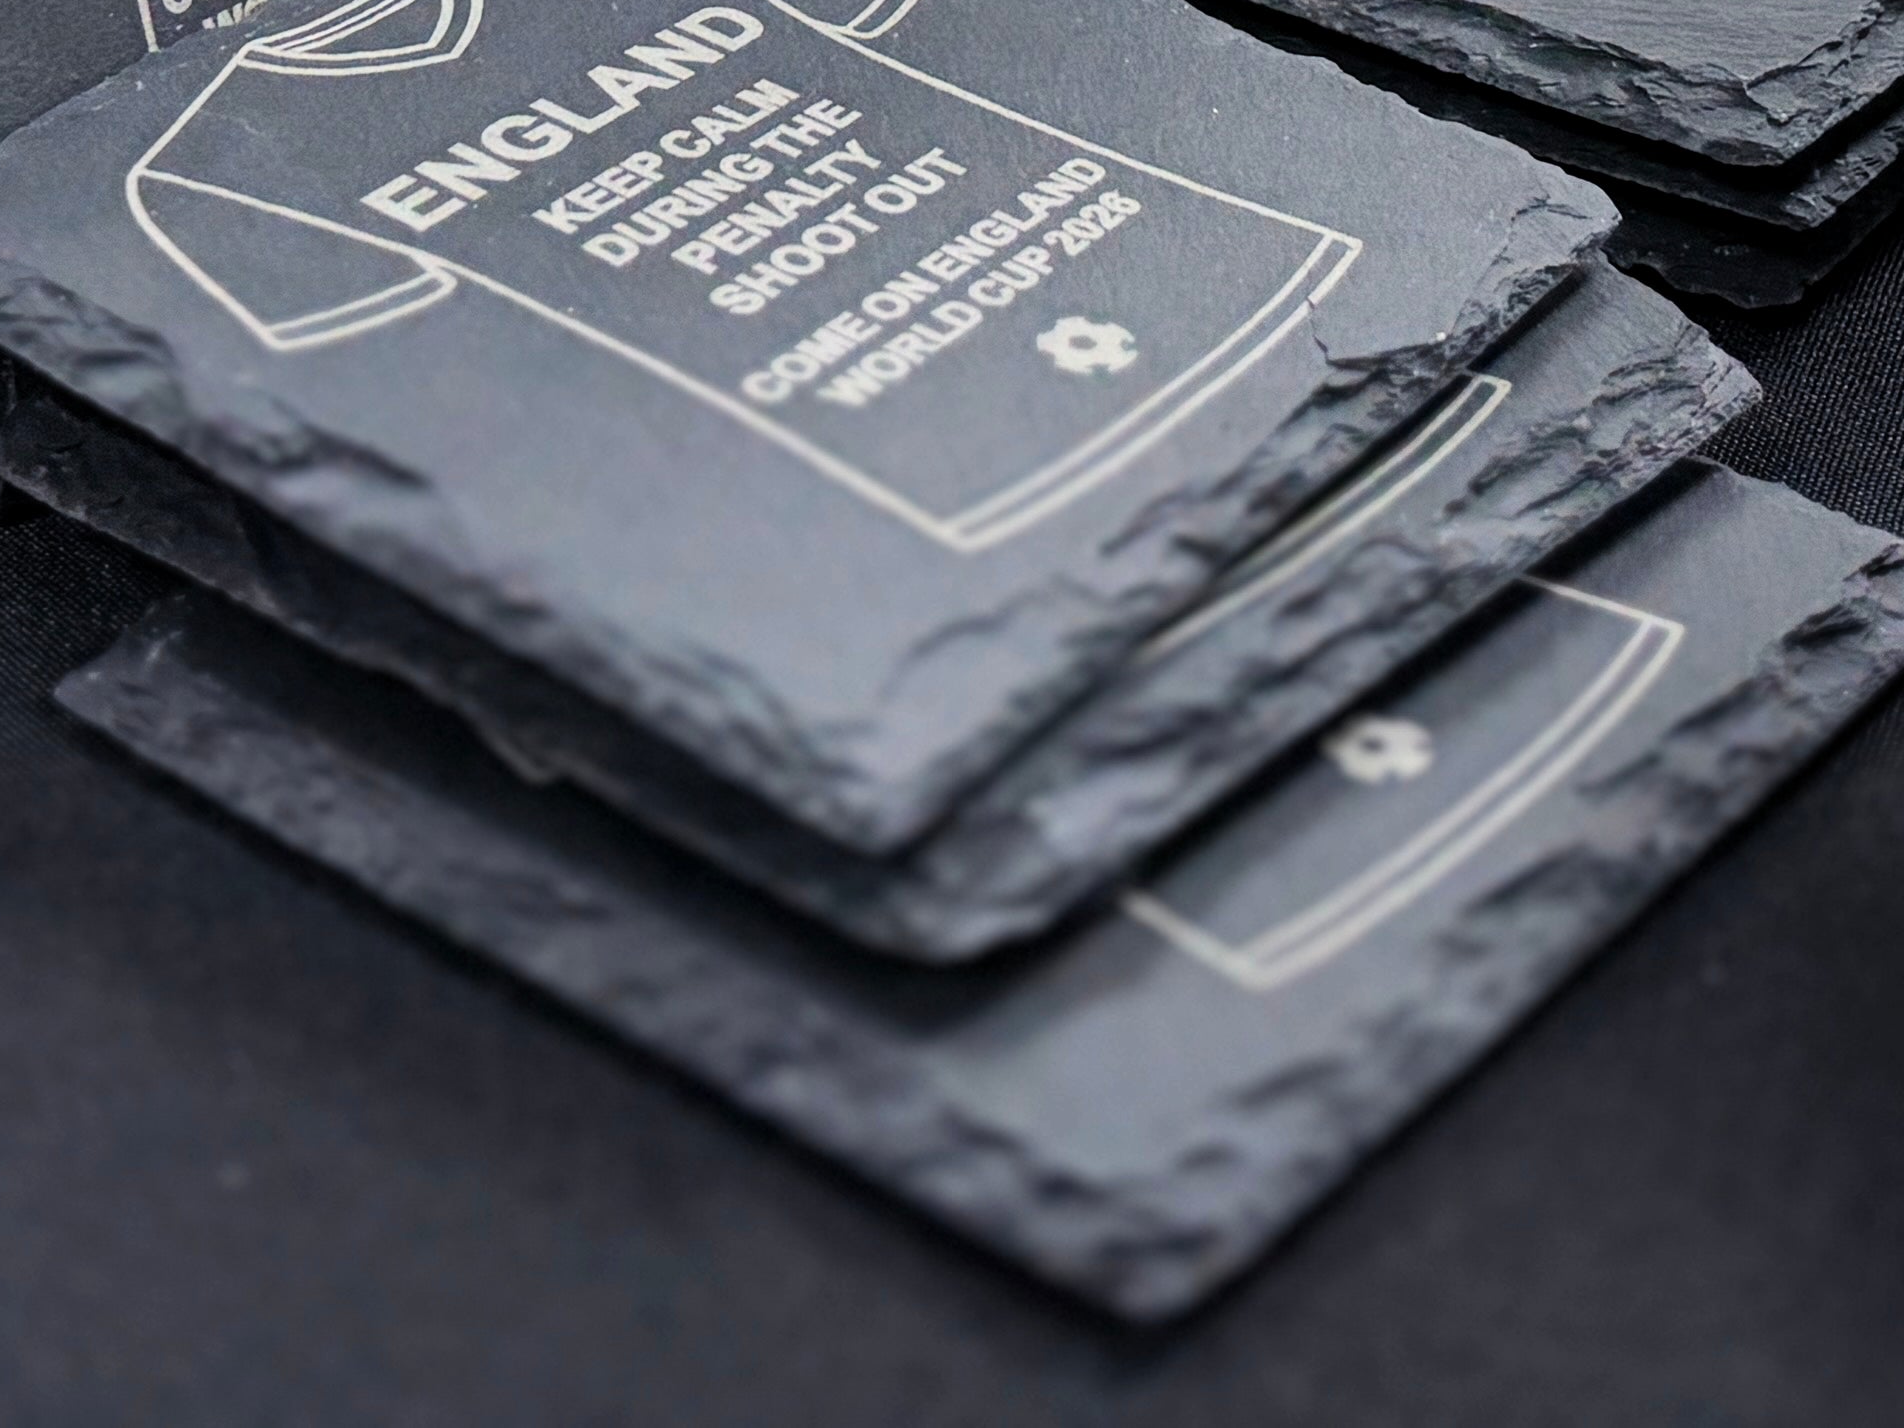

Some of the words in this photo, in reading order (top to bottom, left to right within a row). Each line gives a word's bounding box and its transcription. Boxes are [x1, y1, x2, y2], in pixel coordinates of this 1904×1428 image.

[360, 5, 765, 232] ENGLAND
[533, 149, 669, 235] KEEP
[660, 78, 800, 163] CALM
[582, 155, 765, 267] DURING
[759, 98, 862, 167] THE
[671, 139, 884, 275] PENALTY
[710, 208, 879, 317] SHOOT
[865, 147, 968, 227] OUT
[740, 305, 879, 407] COME
[869, 260, 942, 325] ON
[919, 156, 1107, 296] ENGLAND
[817, 300, 985, 410] WORLD
[969, 245, 1053, 311] CUP
[1046, 190, 1142, 261] 2026
